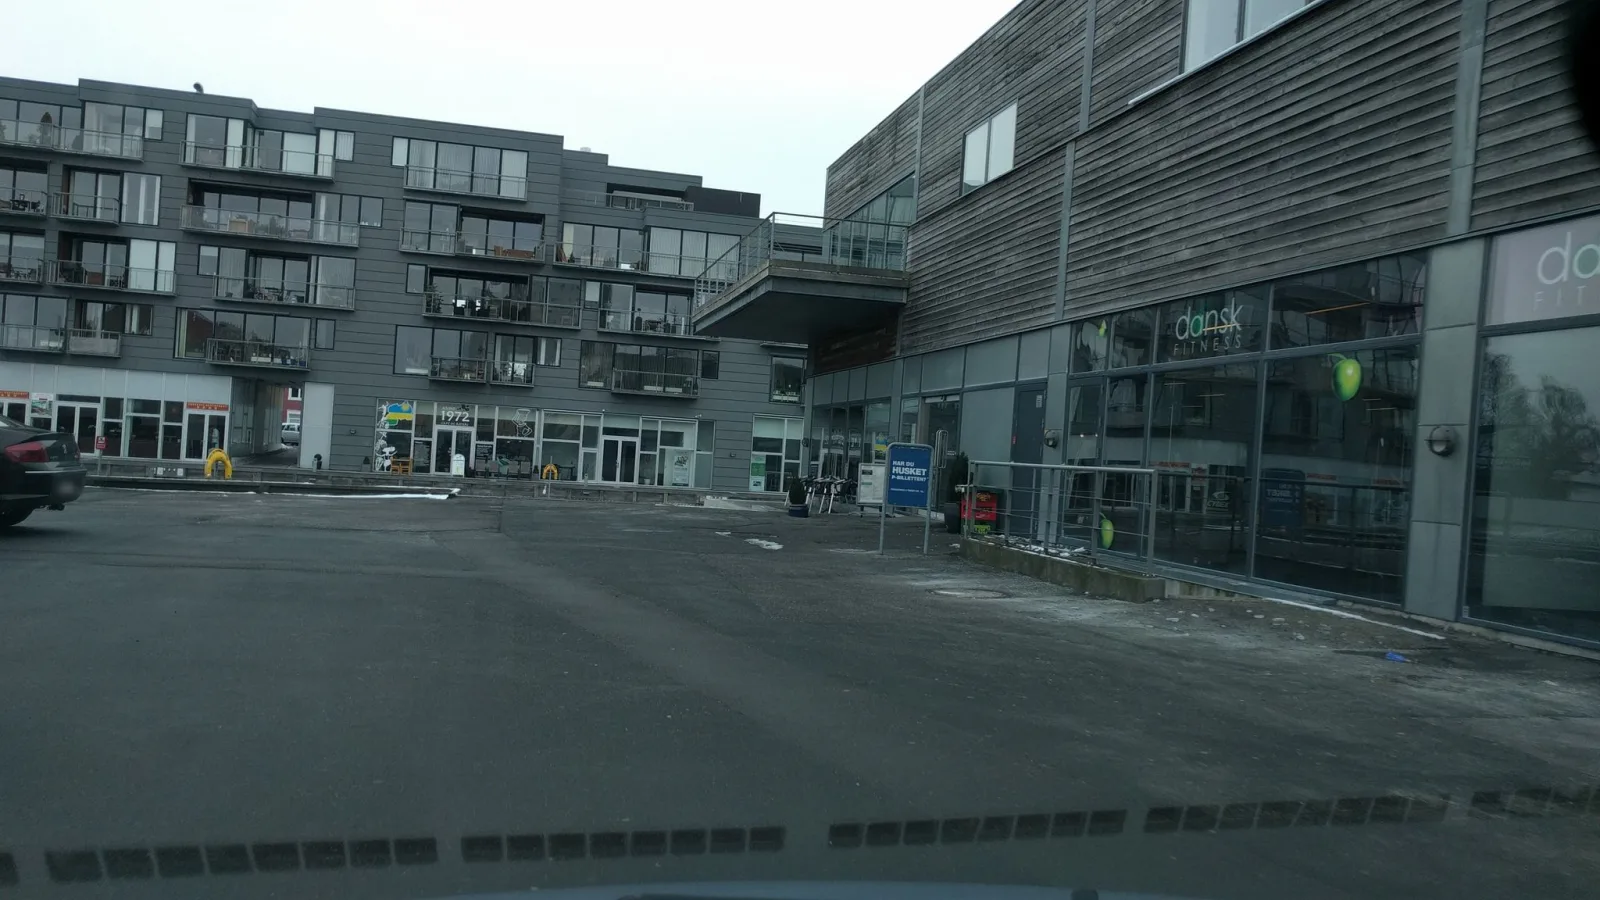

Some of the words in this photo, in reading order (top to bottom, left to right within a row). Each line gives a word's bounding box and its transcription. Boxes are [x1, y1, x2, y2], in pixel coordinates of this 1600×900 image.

[1175, 297, 1244, 341] dansk
[1173, 334, 1242, 356] FITNESS
[441, 410, 470, 422] 1972
[892, 466, 927, 476] HUSKET
